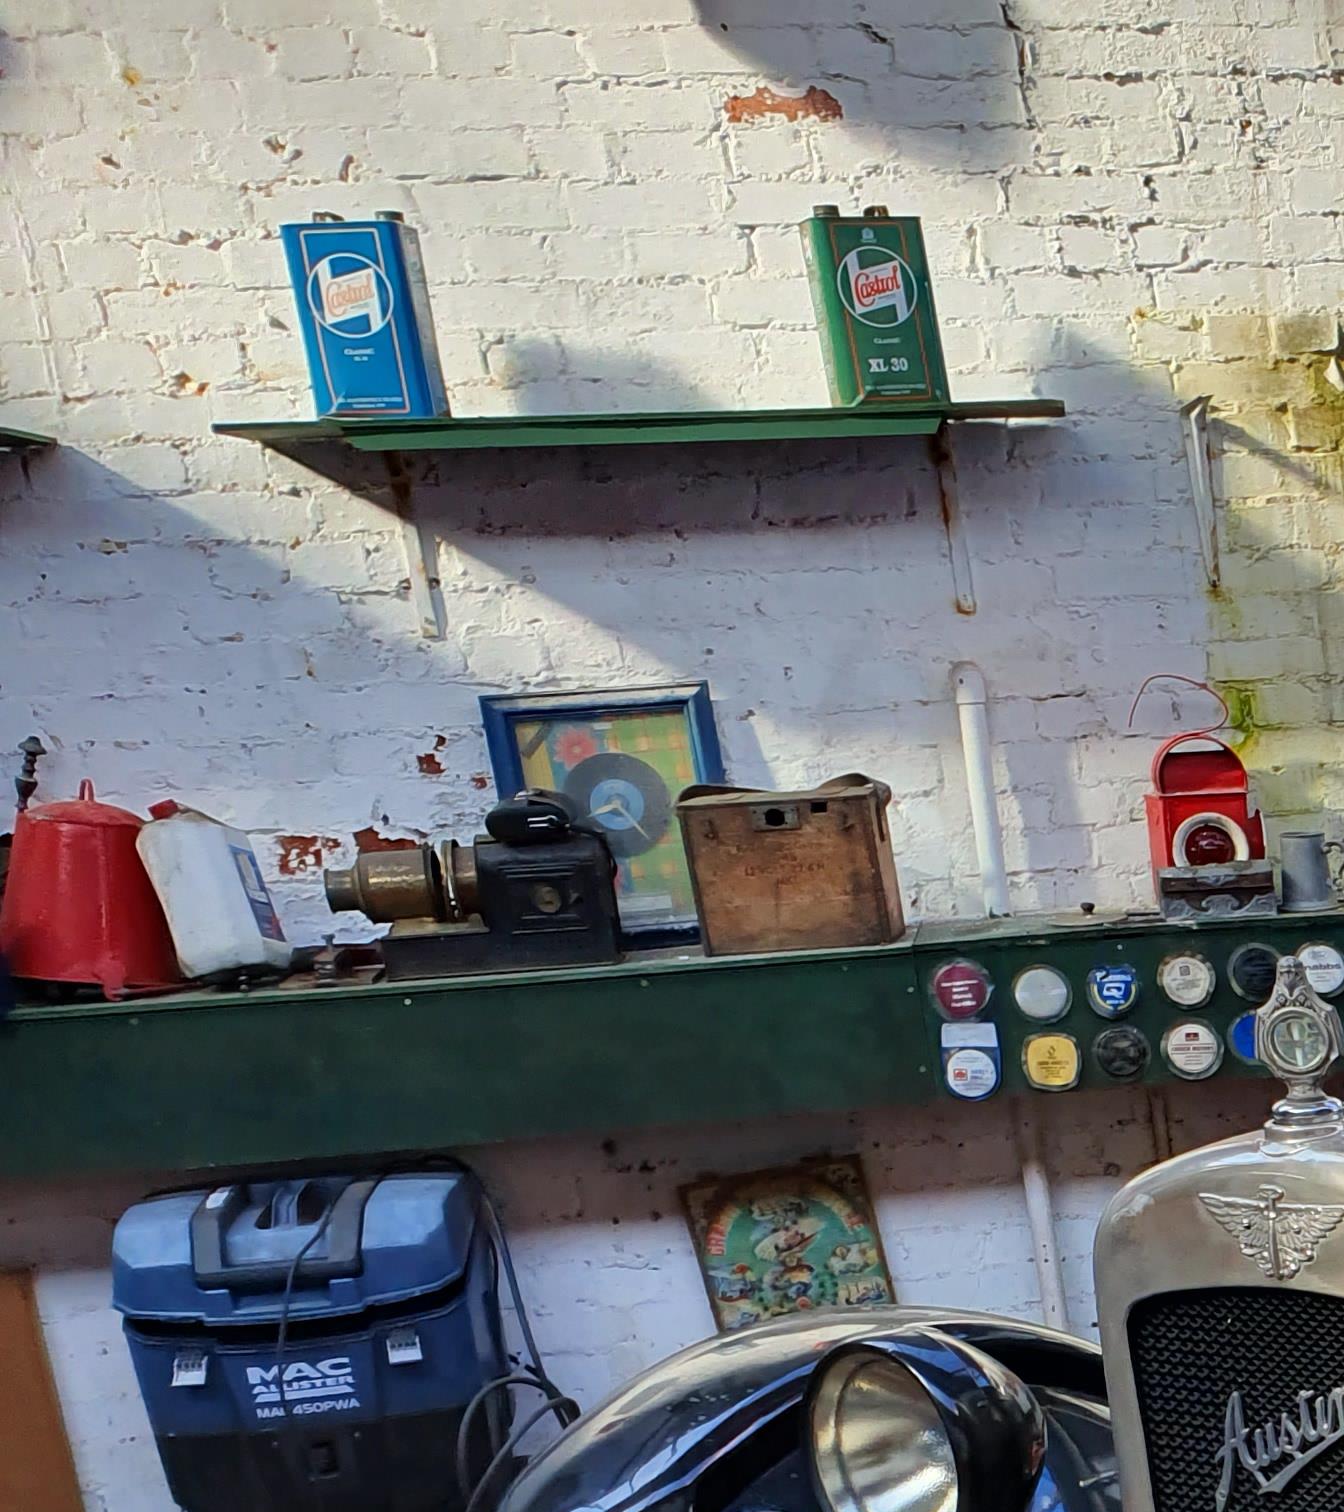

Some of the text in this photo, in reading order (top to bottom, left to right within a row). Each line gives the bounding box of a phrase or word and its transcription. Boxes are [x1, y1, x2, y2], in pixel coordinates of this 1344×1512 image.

[854, 264, 901, 307] Castrol
[868, 356, 909, 373] XL 30
[246, 1357, 352, 1385] MAC
[292, 1397, 361, 1415] 450PWA
